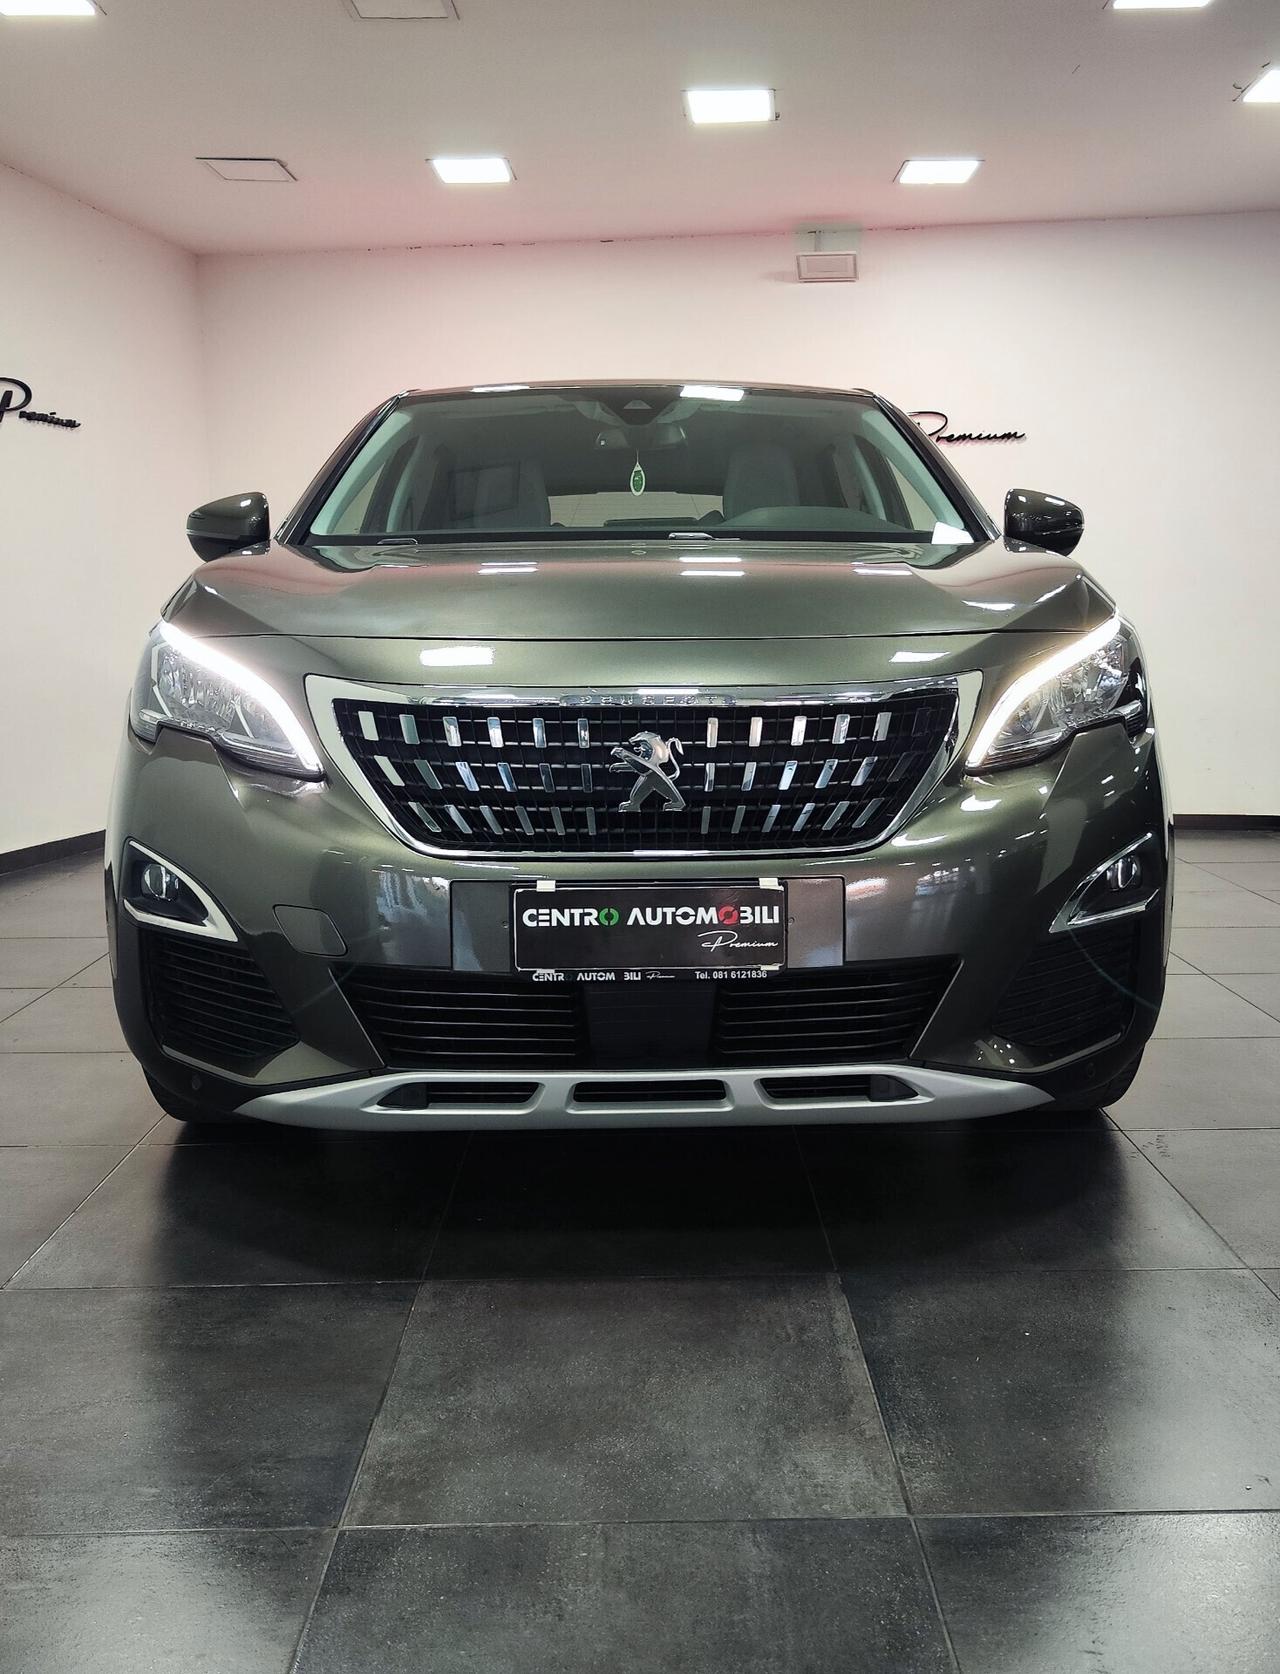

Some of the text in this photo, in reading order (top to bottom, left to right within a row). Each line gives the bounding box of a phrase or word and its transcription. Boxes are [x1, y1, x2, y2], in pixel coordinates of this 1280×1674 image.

[522, 906, 779, 926] CENTRO AUTOMOBILI
[697, 930, 779, 952] Premium
[695, 970, 768, 980] Tel. 081 6121836
